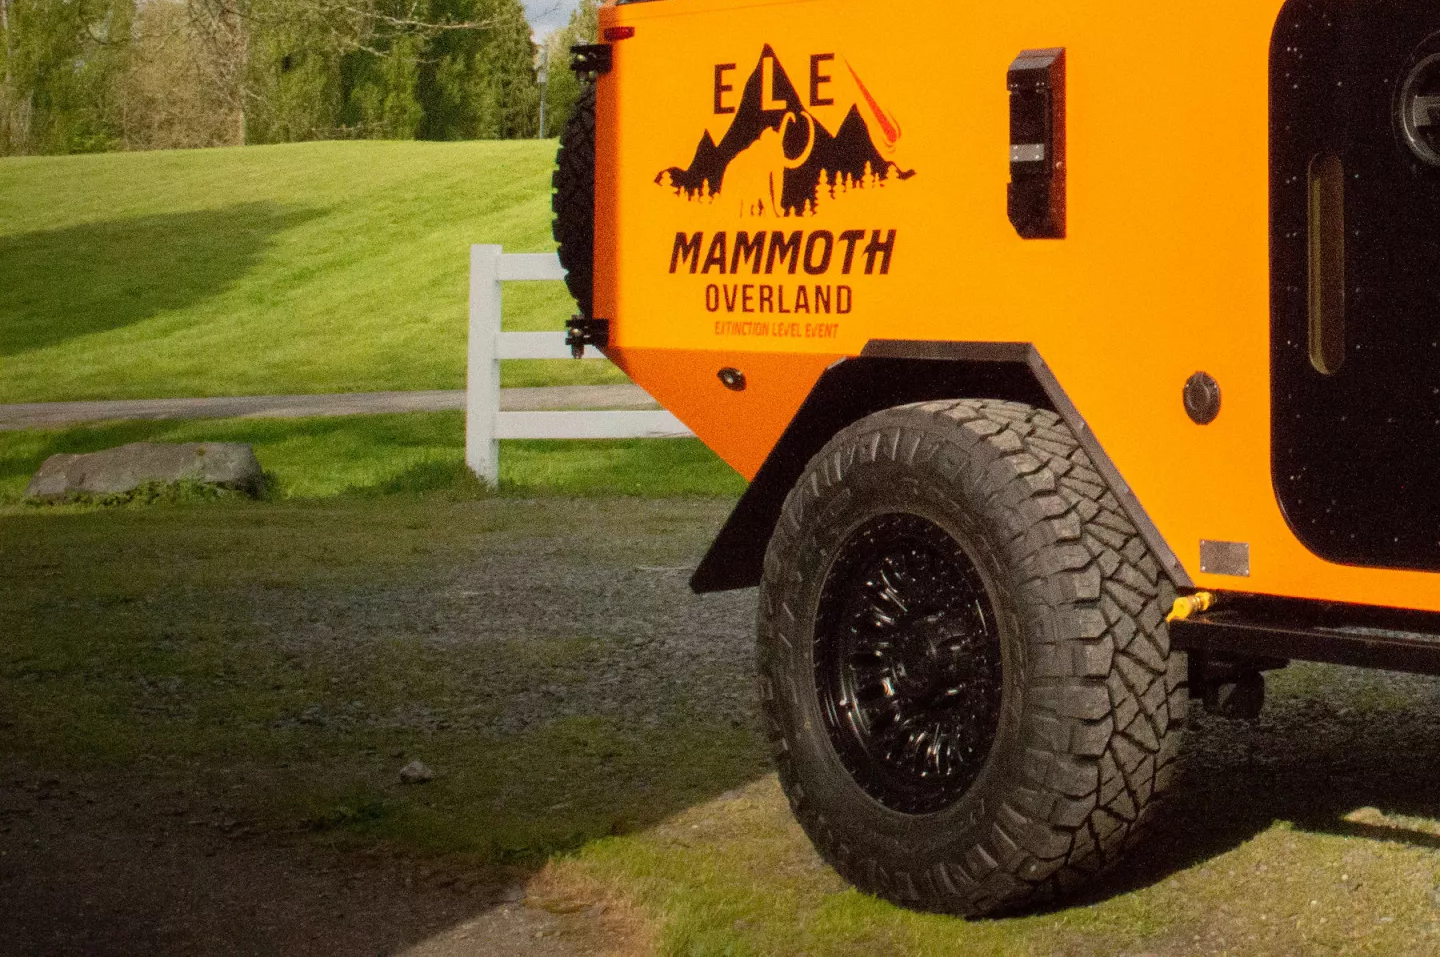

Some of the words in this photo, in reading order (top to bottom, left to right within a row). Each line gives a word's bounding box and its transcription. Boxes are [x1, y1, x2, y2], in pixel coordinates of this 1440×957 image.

[713, 53, 836, 115] ELE
[668, 228, 897, 276] MAMMOTH
[705, 283, 853, 314] OVERLAND
[714, 320, 770, 337] EXTINCTION
[771, 322, 803, 338] LEVEL
[804, 323, 839, 339] EVENT
